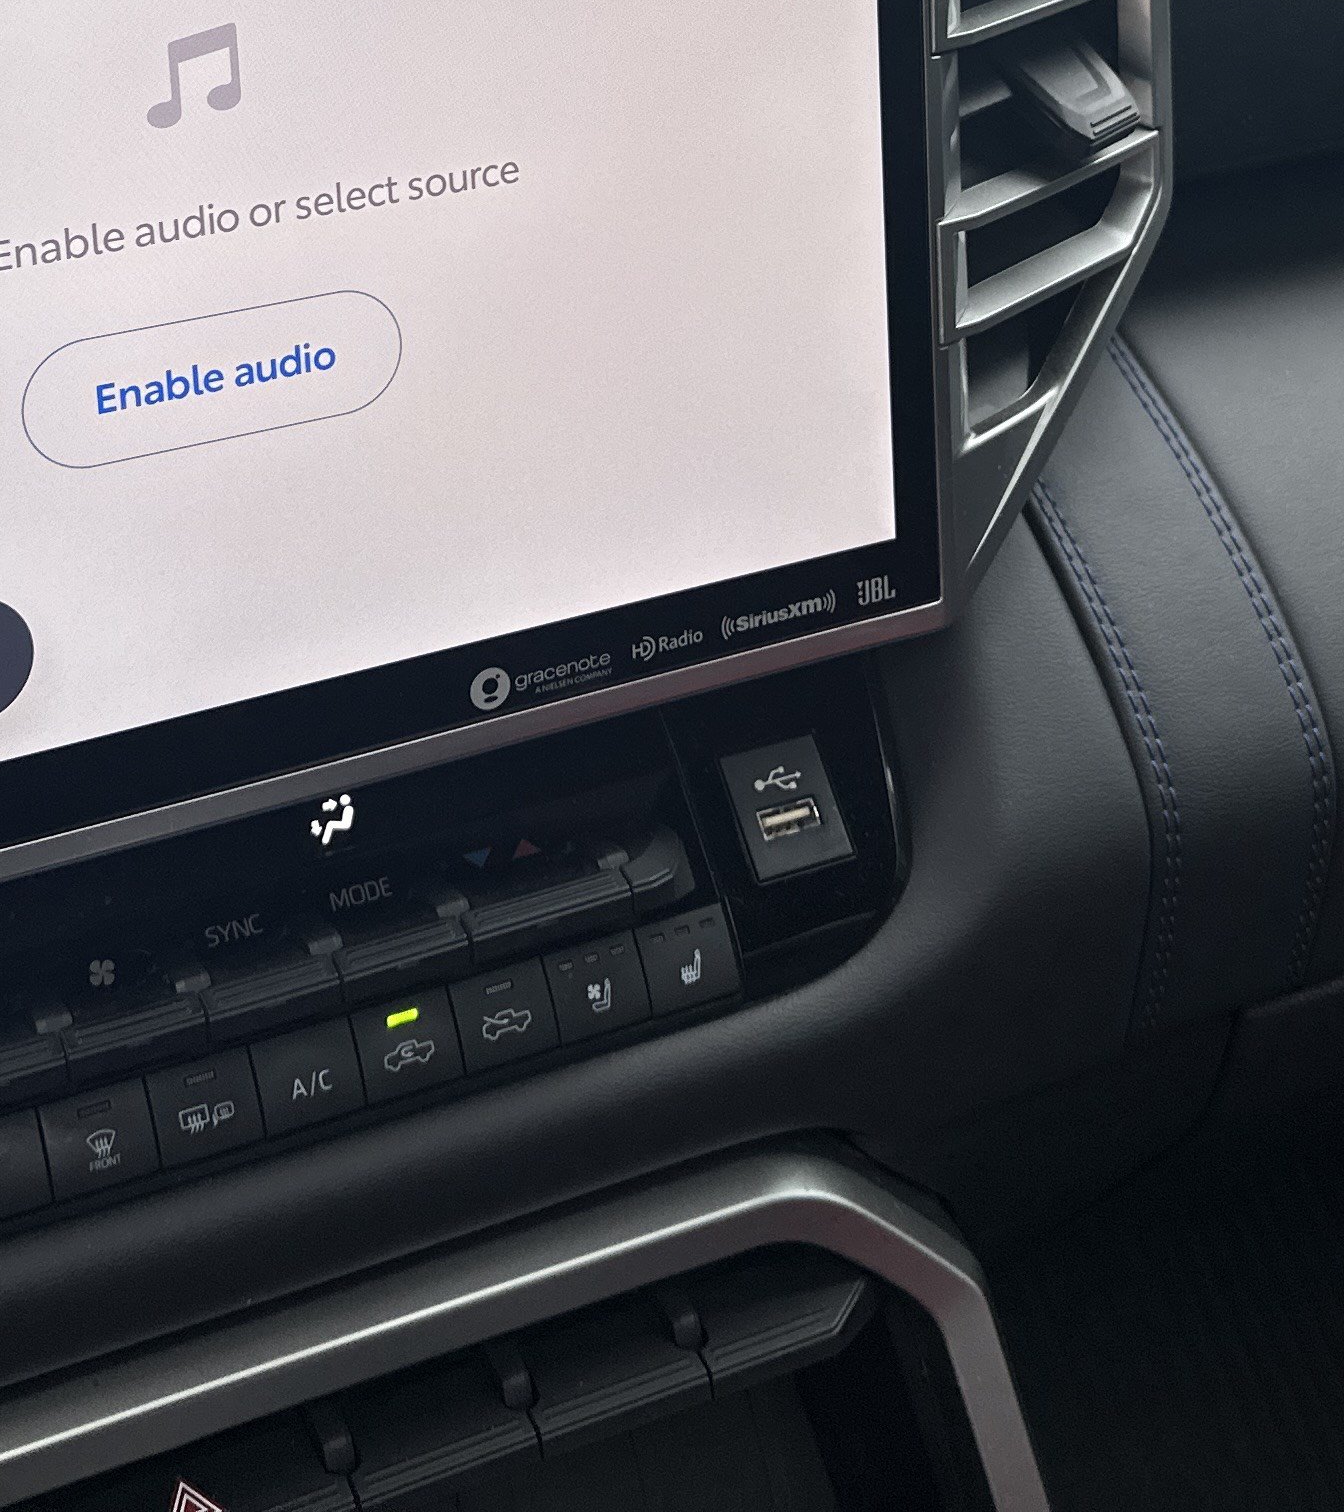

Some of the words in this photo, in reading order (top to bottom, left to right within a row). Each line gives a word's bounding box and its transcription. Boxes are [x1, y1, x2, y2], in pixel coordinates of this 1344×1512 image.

[133, 203, 241, 249] audio
[247, 197, 287, 229] or
[293, 175, 400, 222] select
[406, 157, 521, 202] source
[95, 361, 225, 416] Enable
[232, 341, 337, 388] audio
[856, 574, 897, 607] JBL
[658, 626, 705, 654] Radio
[515, 651, 612, 693] gracenote
[328, 876, 392, 914] MODE
[204, 913, 265, 949] SYNC
[291, 1067, 335, 1102] A/C
[88, 1152, 123, 1172] FRONT
